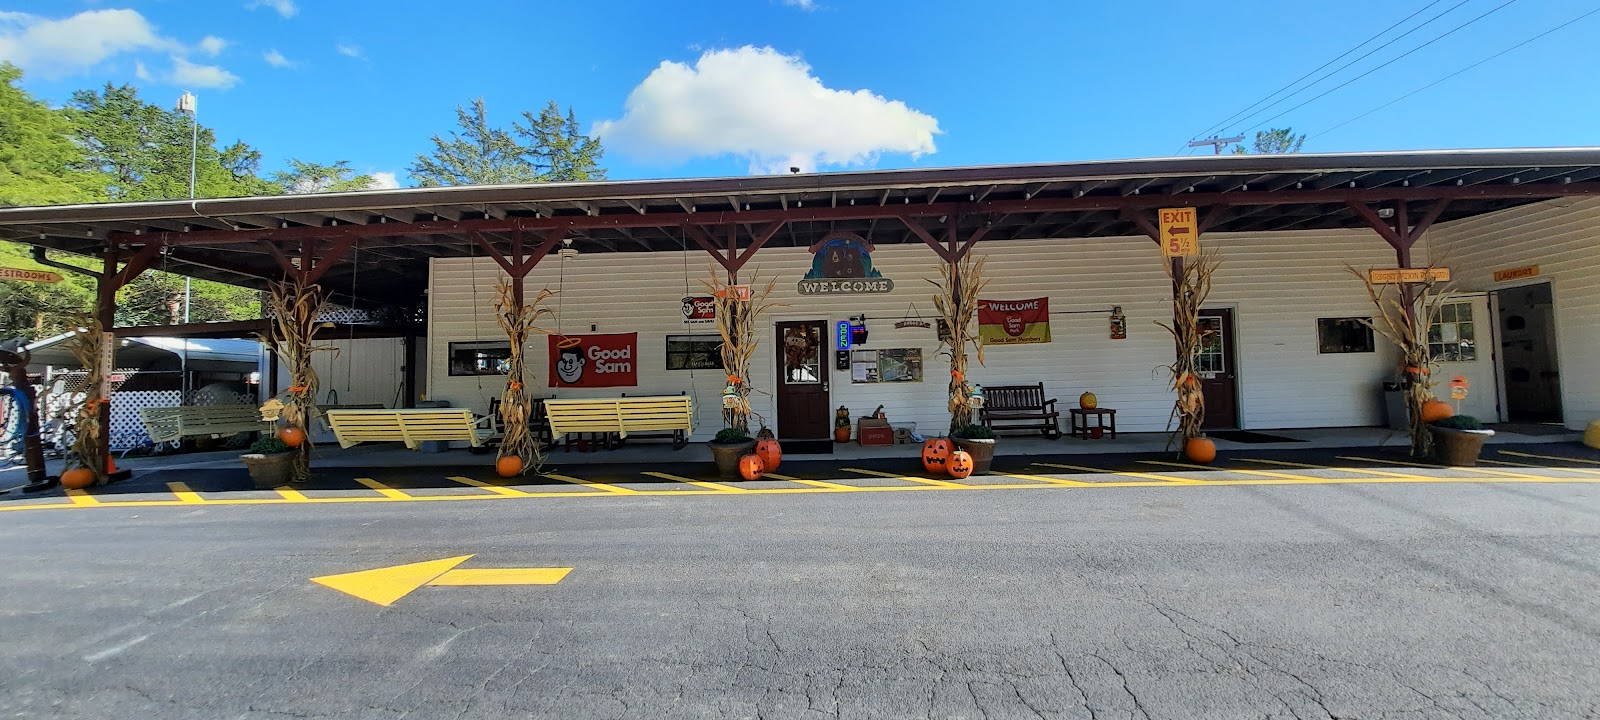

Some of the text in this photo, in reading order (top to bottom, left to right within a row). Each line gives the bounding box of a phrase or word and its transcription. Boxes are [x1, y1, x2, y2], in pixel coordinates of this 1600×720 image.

[1163, 211, 1191, 223] EXIT
[1374, 272, 1418, 281] REGISTRTION
[1499, 267, 1532, 280] LAUNDRY
[802, 281, 888, 293] WELCOME
[697, 306, 714, 314] Sam
[988, 301, 1039, 311] WELCOME
[840, 323, 848, 348] OPEN
[588, 345, 631, 360] Good
[595, 359, 631, 374] Sam
